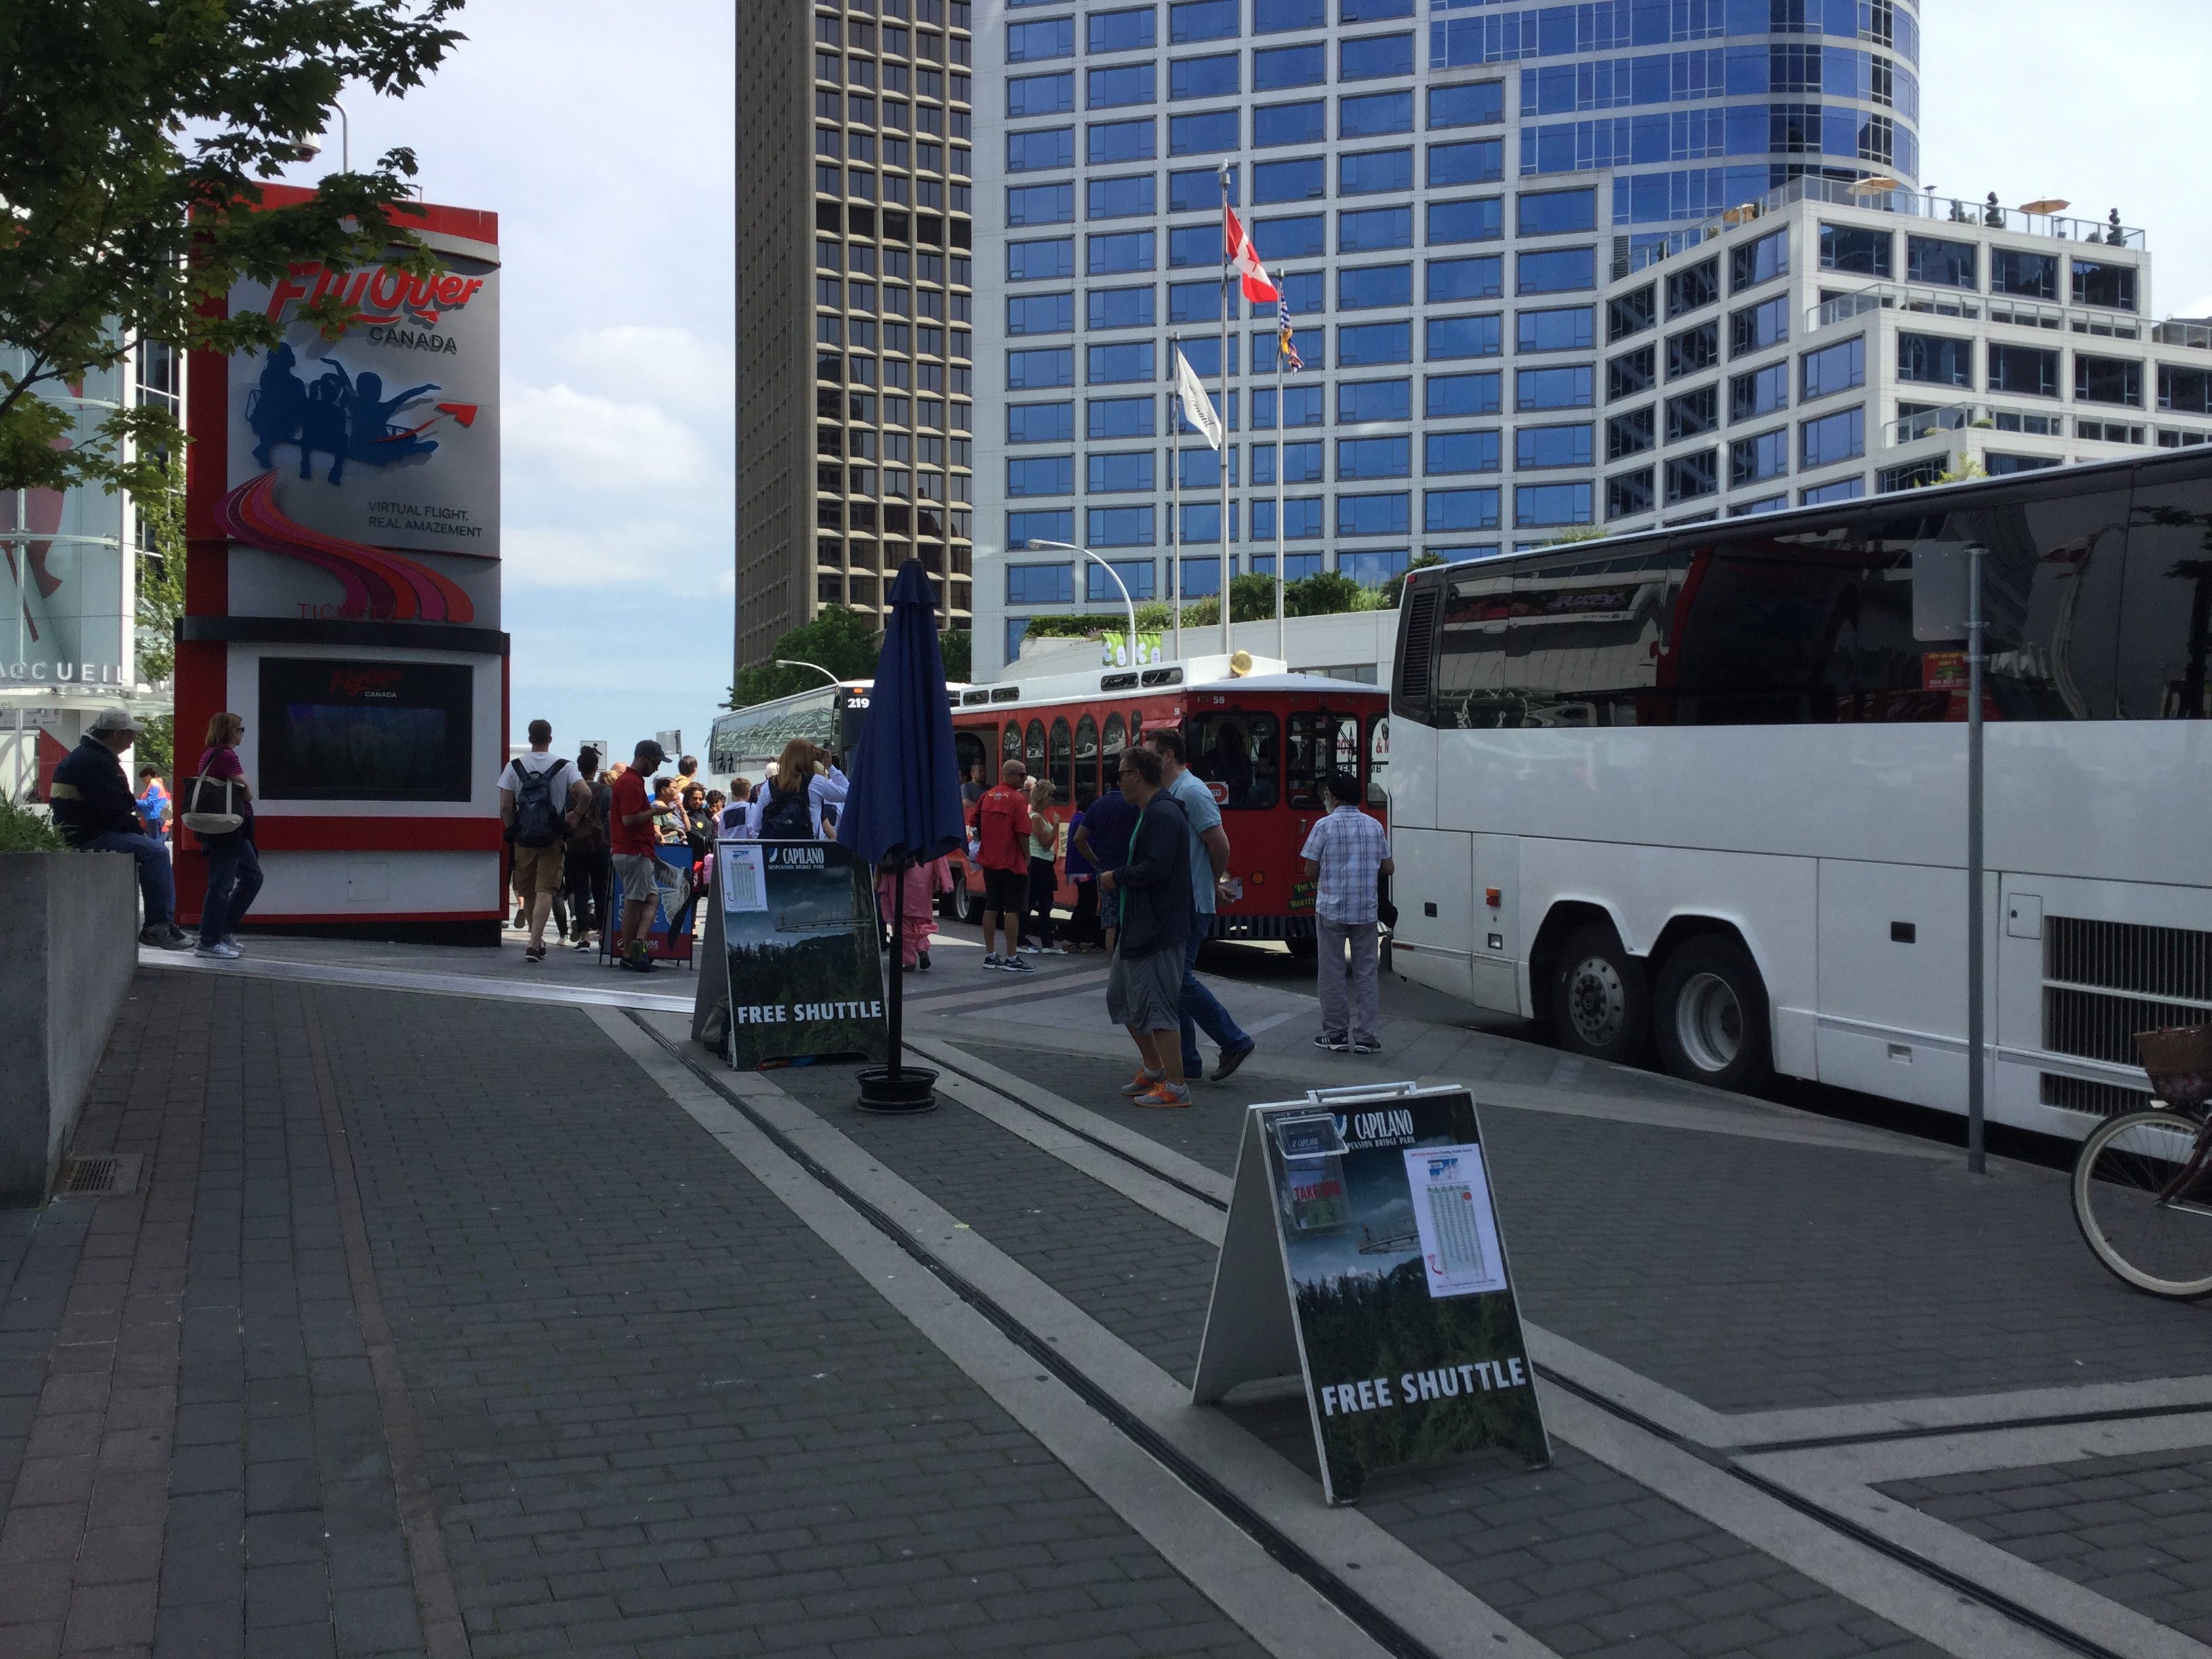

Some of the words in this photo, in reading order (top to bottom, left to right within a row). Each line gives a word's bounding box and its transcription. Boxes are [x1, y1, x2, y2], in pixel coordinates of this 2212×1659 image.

[369, 327, 458, 354] CANADA
[369, 501, 422, 515] VIRTUAL
[425, 506, 469, 521] FLIGHT.
[369, 516, 402, 529] REAL
[405, 520, 483, 538] AMAZEMENT
[847, 697, 870, 708] 219
[1213, 696, 1225, 704] 58
[783, 848, 825, 864] CAPILANO
[738, 1005, 787, 1024] FREE
[794, 1000, 882, 1021] SHUTTLE
[1355, 1109, 1414, 1140] CAPILANO
[1375, 1138, 1397, 1147] BRIDGE
[1399, 1136, 1416, 1145] PARK
[1294, 1183, 1319, 1201] TAKE
[1322, 1377, 1393, 1416] FREE
[1401, 1357, 1526, 1404] SHUTTLE
